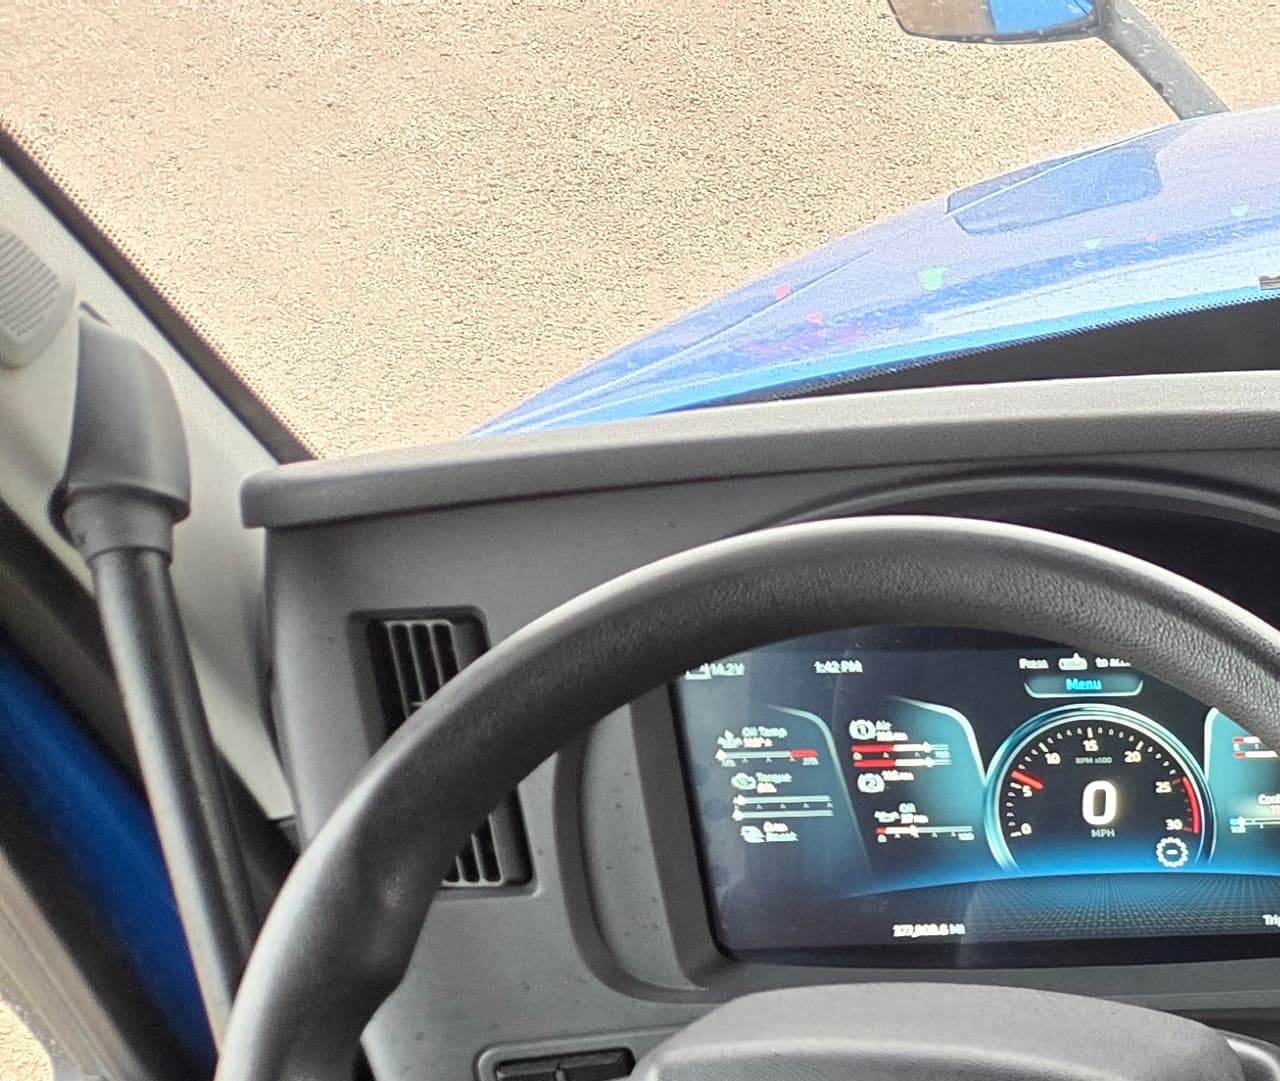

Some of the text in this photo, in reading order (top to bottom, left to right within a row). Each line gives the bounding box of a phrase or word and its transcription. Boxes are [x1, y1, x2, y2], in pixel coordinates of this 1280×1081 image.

[815, 661, 863, 674] 1:42 PM
[1066, 678, 1102, 690] Menu
[1082, 740, 1099, 752] 15
[1045, 753, 1061, 765] 10
[1124, 751, 1142, 763] 20
[1155, 782, 1172, 793] 25
[1082, 780, 1117, 826] 0
[1021, 823, 1032, 835] 0
[1165, 820, 1183, 831] 30
[1091, 828, 1115, 838] MPH
